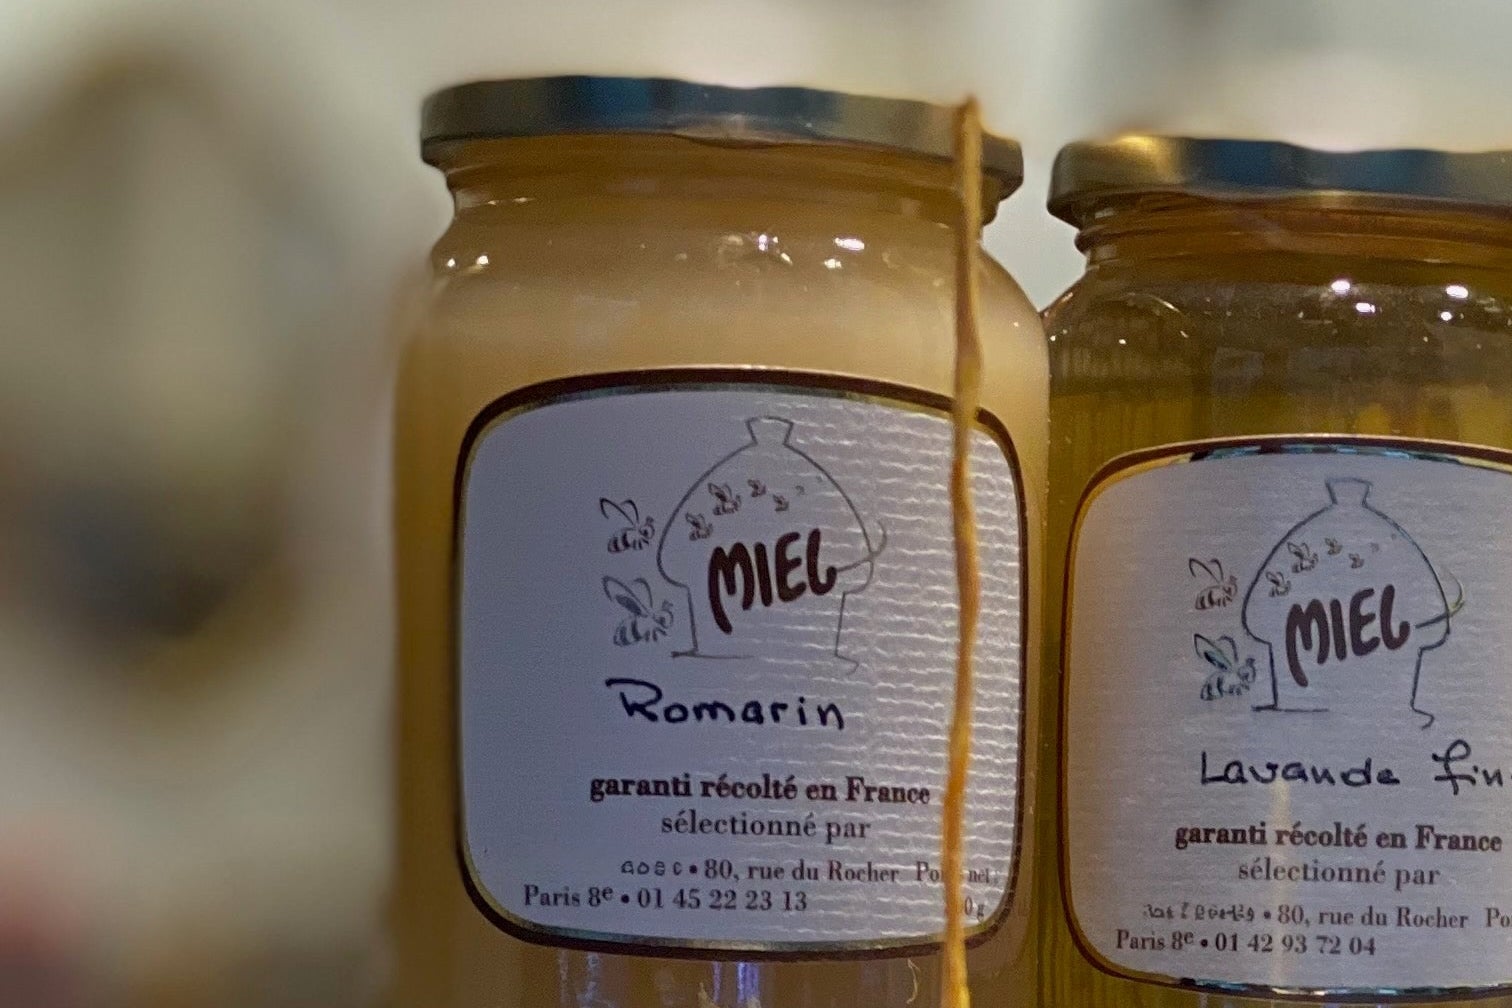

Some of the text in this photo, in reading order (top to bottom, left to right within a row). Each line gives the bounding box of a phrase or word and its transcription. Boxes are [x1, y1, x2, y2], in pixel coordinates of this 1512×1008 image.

[708, 529, 837, 635] MIEL
[1285, 584, 1412, 687] MIEL
[605, 677, 844, 729] Romarin
[1200, 751, 1400, 787] Lavande
[590, 773, 930, 804] garanti récolté en France
[661, 809, 871, 844] sélectionné par
[1175, 822, 1502, 852] garanti récolté en France
[747, 864, 784, 880] rue
[792, 859, 819, 881] du
[828, 860, 899, 882] Rocher
[1239, 858, 1440, 890] sélectionné par
[524, 884, 807, 911] Paris 01 45 22 23 13
[1318, 912, 1353, 926] rue
[1361, 906, 1387, 927] du
[1396, 907, 1469, 929] Rocher
[1116, 930, 1376, 955] Paris 01 42 93 72 04
